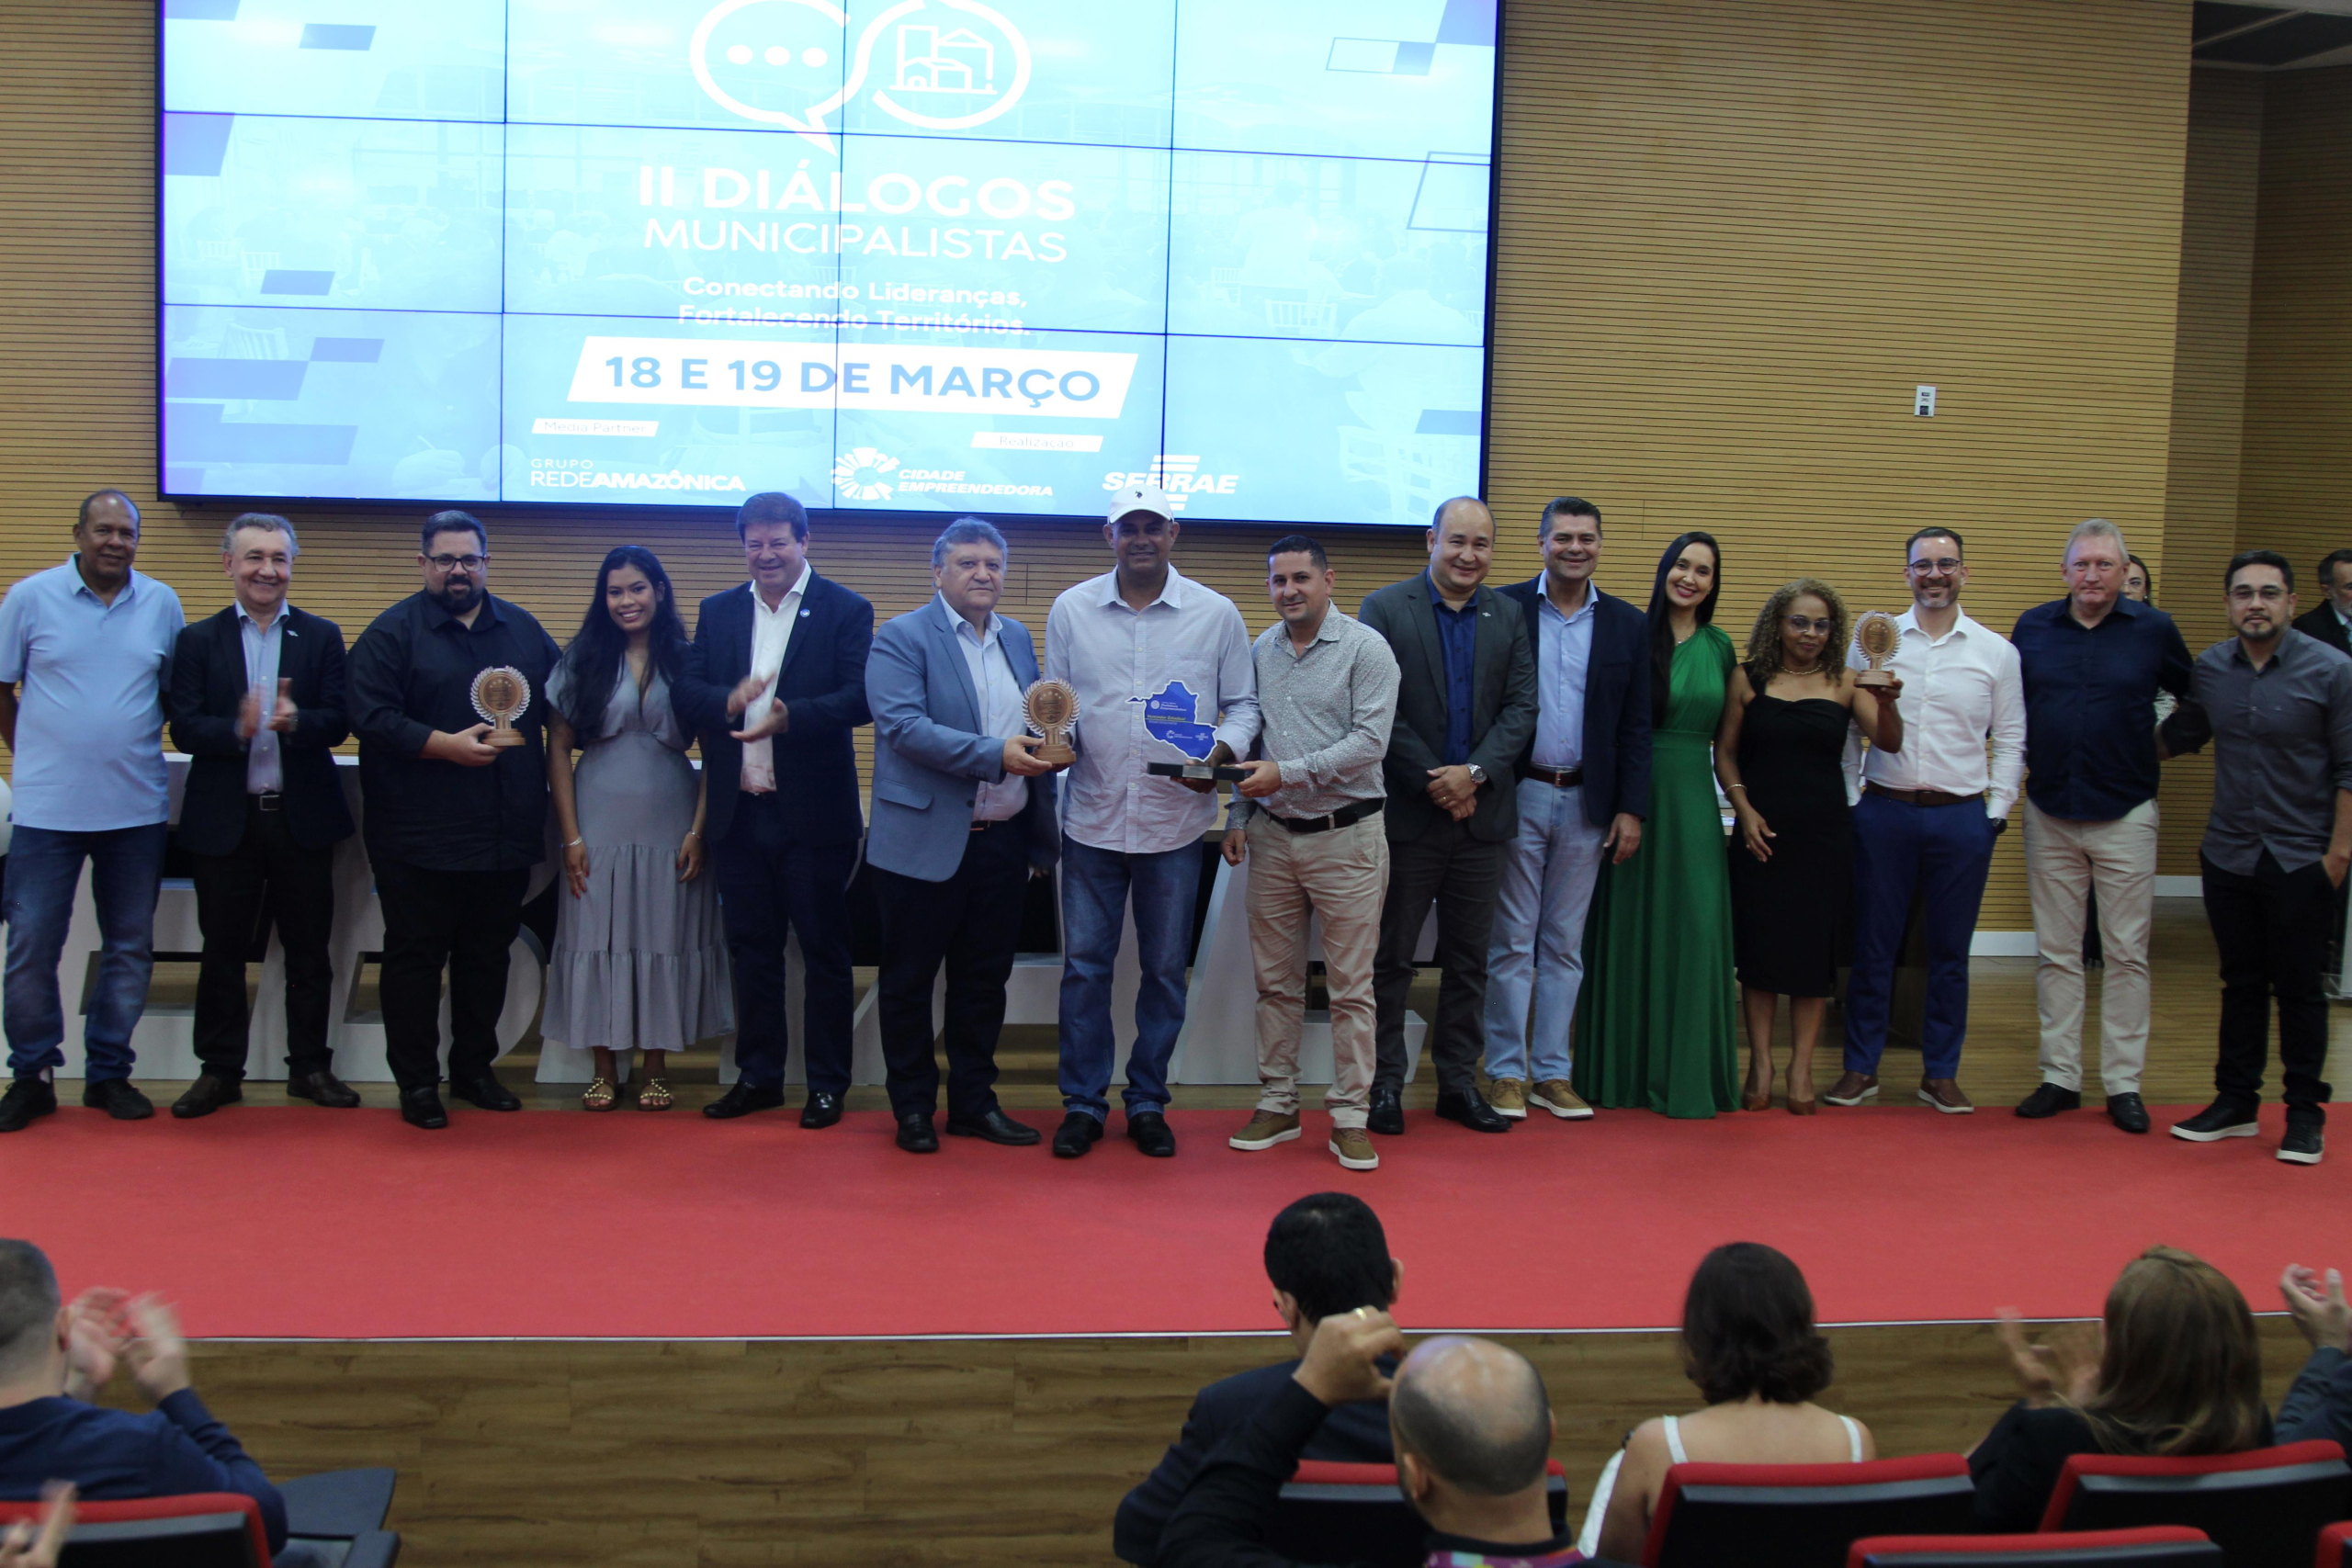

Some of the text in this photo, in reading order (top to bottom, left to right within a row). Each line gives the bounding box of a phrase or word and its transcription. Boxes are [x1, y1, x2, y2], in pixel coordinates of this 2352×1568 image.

[640, 159, 1076, 220] II DIÁLOGOS
[644, 218, 1067, 263] MUNICIPALISTAS
[683, 276, 1027, 308] Conectando Lideranças,
[678, 304, 1030, 335] Fortalecendo Territórios.
[605, 356, 1100, 409] 18 E 19 DE MARÇO
[544, 422, 647, 434] Media Partner
[1000, 435, 1074, 449] Realização
[531, 458, 594, 470] GRUPO
[898, 468, 966, 481] CIDADE
[530, 469, 746, 491] REDEAMAZÔNICA
[898, 481, 1053, 497] EMPREENDEDORA
[1102, 472, 1239, 494] SEBRAE
